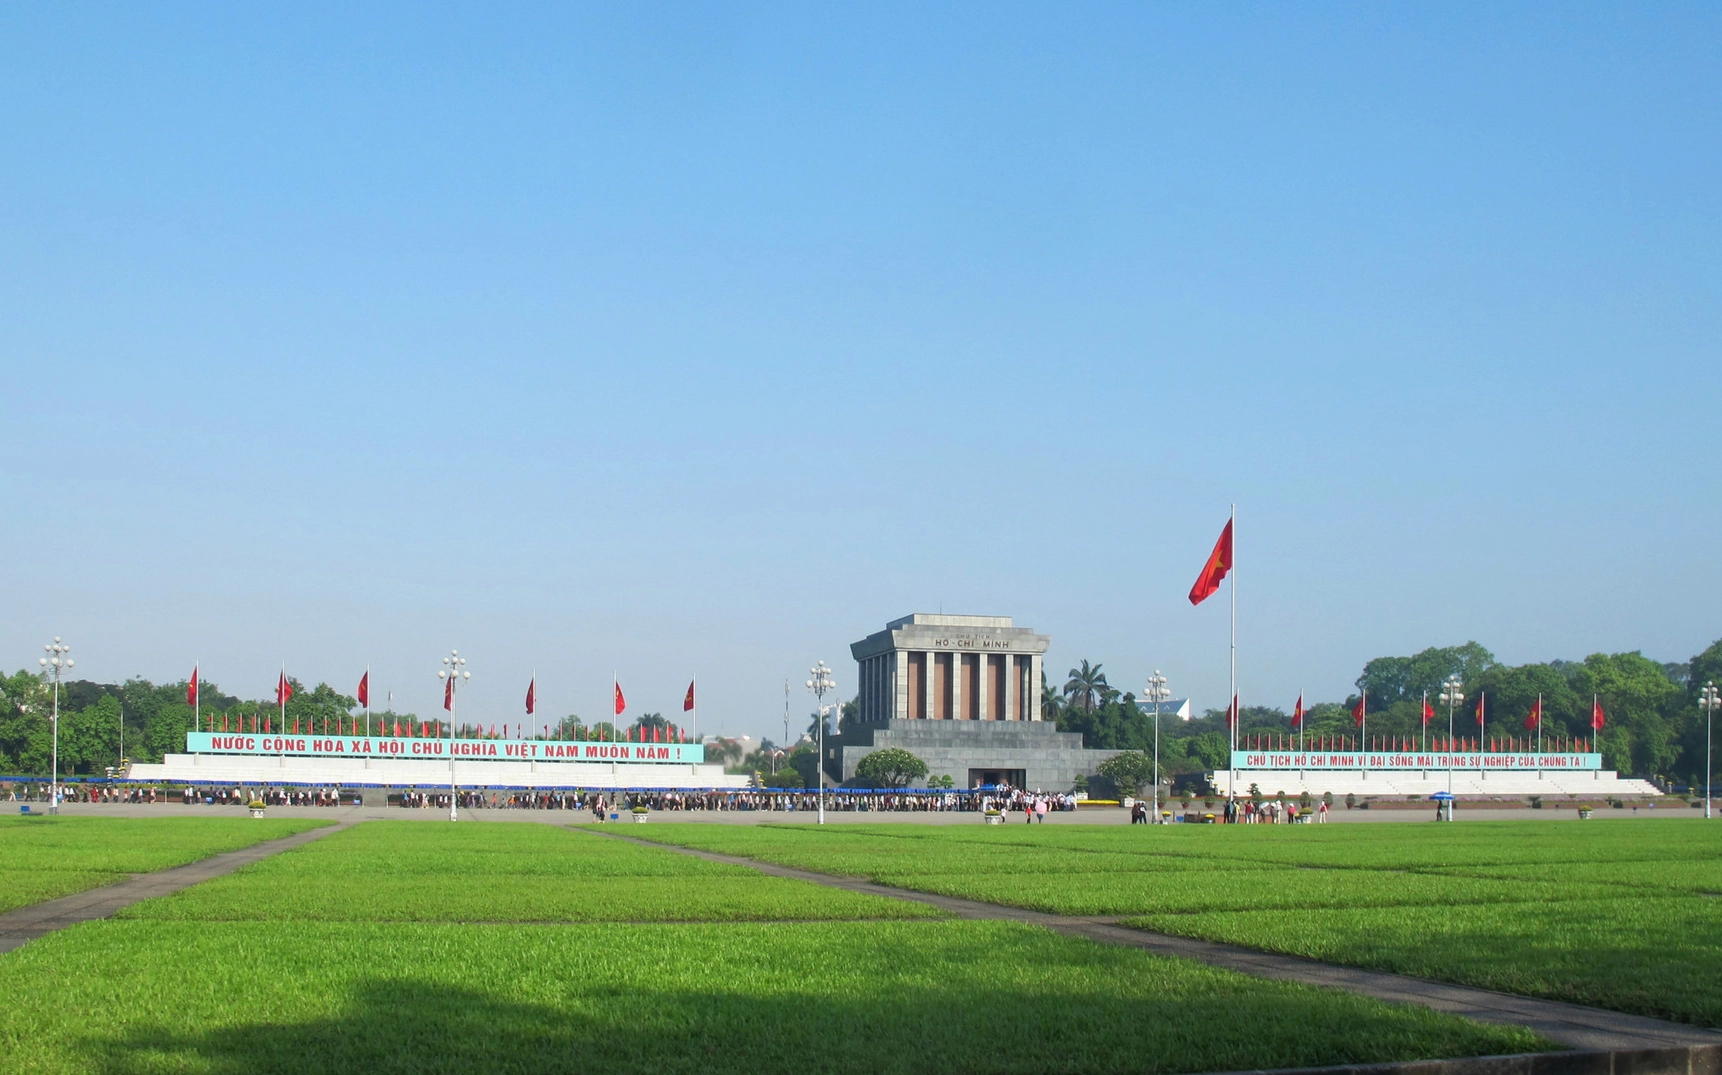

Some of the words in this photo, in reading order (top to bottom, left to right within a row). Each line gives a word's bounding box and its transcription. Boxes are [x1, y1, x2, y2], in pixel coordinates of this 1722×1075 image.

[983, 640, 1009, 648] MINH
[212, 735, 255, 750] NƯỚC
[262, 736, 306, 753] CỘNG
[313, 737, 344, 752] HÒA
[351, 738, 371, 753] XÃ
[379, 739, 405, 756] HỘI
[412, 739, 443, 754] CHỦ
[450, 741, 497, 756] NGHĨA
[505, 741, 537, 758] VIỆT
[545, 744, 579, 758] NAM
[586, 743, 630, 759] MUÔN
[636, 744, 670, 759] NĂM
[676, 747, 681, 760] !
[1270, 755, 1291, 768] TỊCH
[1330, 755, 1354, 766] MINH
[1370, 755, 1385, 768] ĐẠI
[1389, 752, 1413, 766] SỐNG
[1469, 755, 1481, 768] SỰ
[1484, 754, 1515, 769] NGHIỆP
[1518, 754, 1535, 767] CỦA
[1538, 754, 1567, 767] CHÚNG
[1570, 756, 1580, 767] TA
